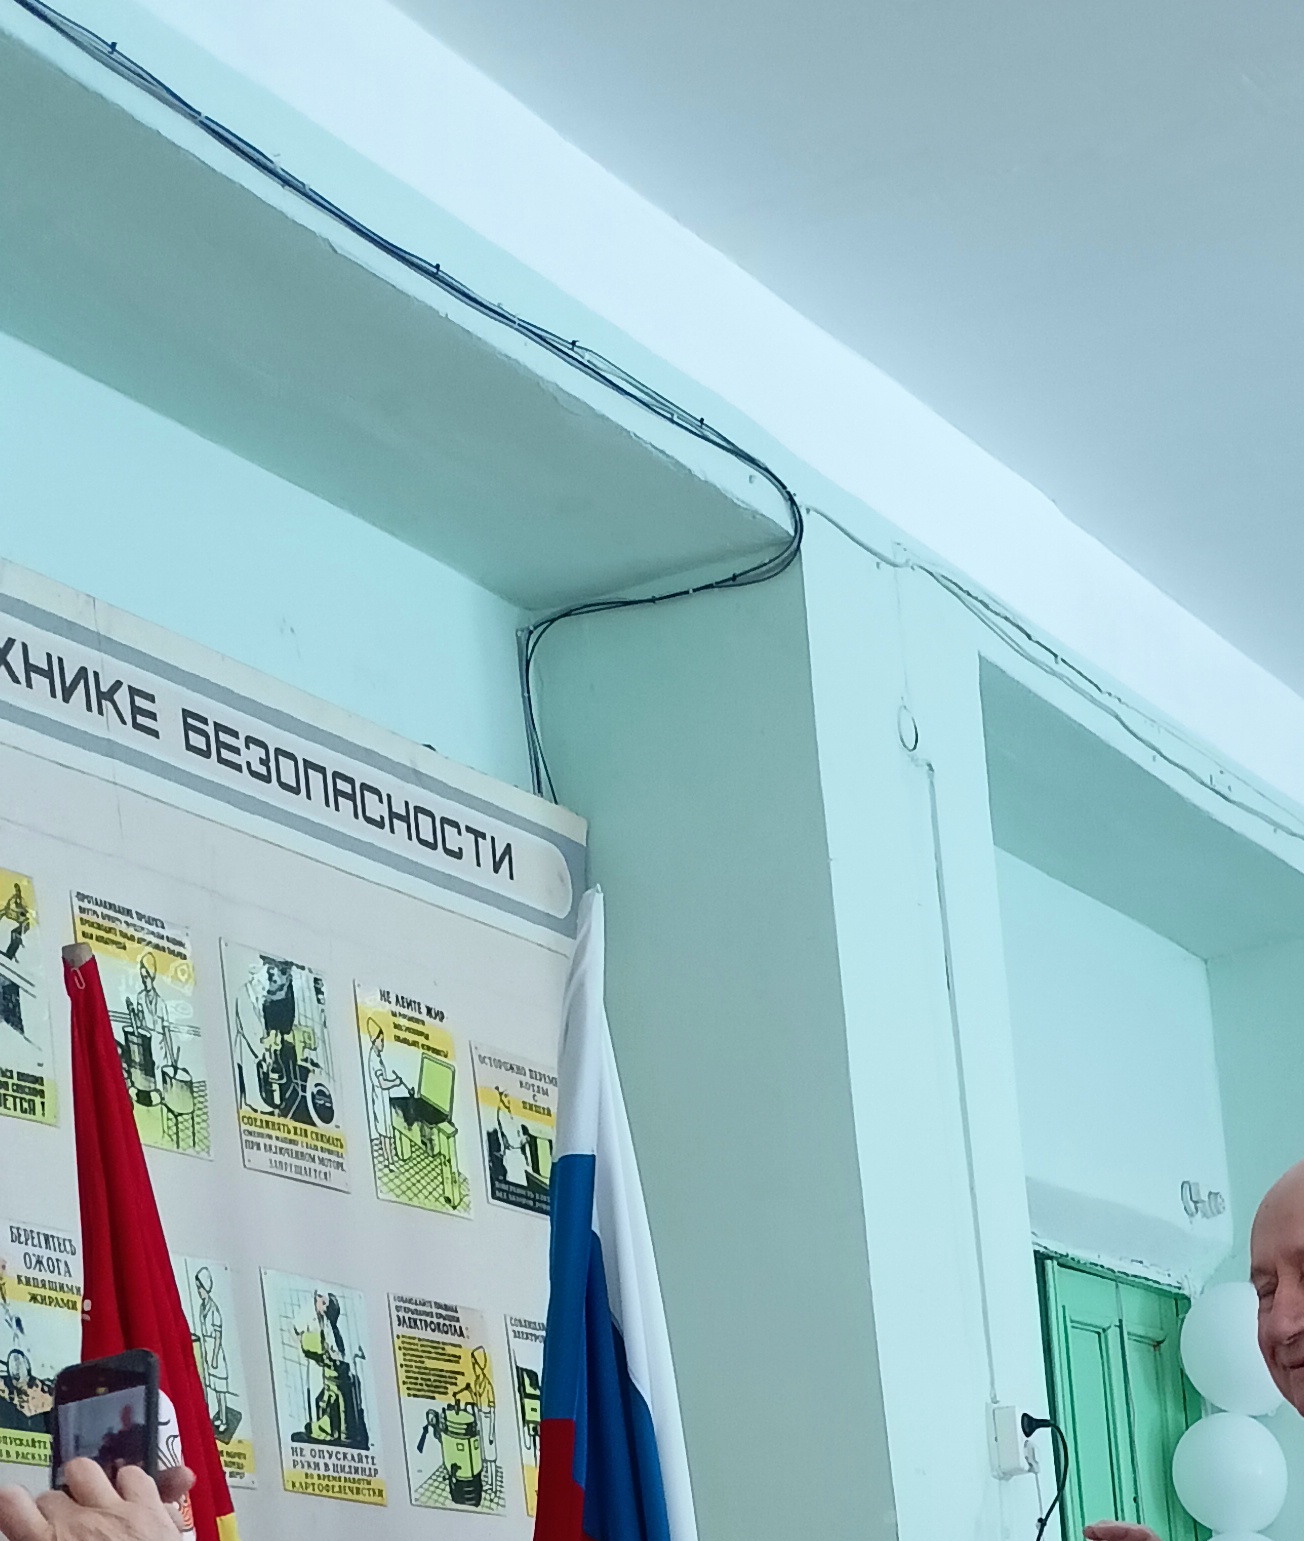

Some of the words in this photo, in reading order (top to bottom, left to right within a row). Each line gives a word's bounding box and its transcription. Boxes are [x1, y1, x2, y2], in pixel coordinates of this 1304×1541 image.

[181, 707, 515, 881] БЕЗОПАСНОСТИ
[379, 988, 391, 1004] НЕ
[9, 1225, 77, 1256] БЕРЕГИТЕСЬ
[23, 1252, 72, 1278] ОЖОГА
[28, 1292, 78, 1311] ЖИРАМИ
[291, 1446, 306, 1458] НЕ
[310, 1448, 377, 1466] ОПУСКАЙТЕ
[292, 1459, 321, 1471] РУКИ
[324, 1462, 330, 1472] В
[332, 1463, 379, 1478] ЦИЛИНДР
